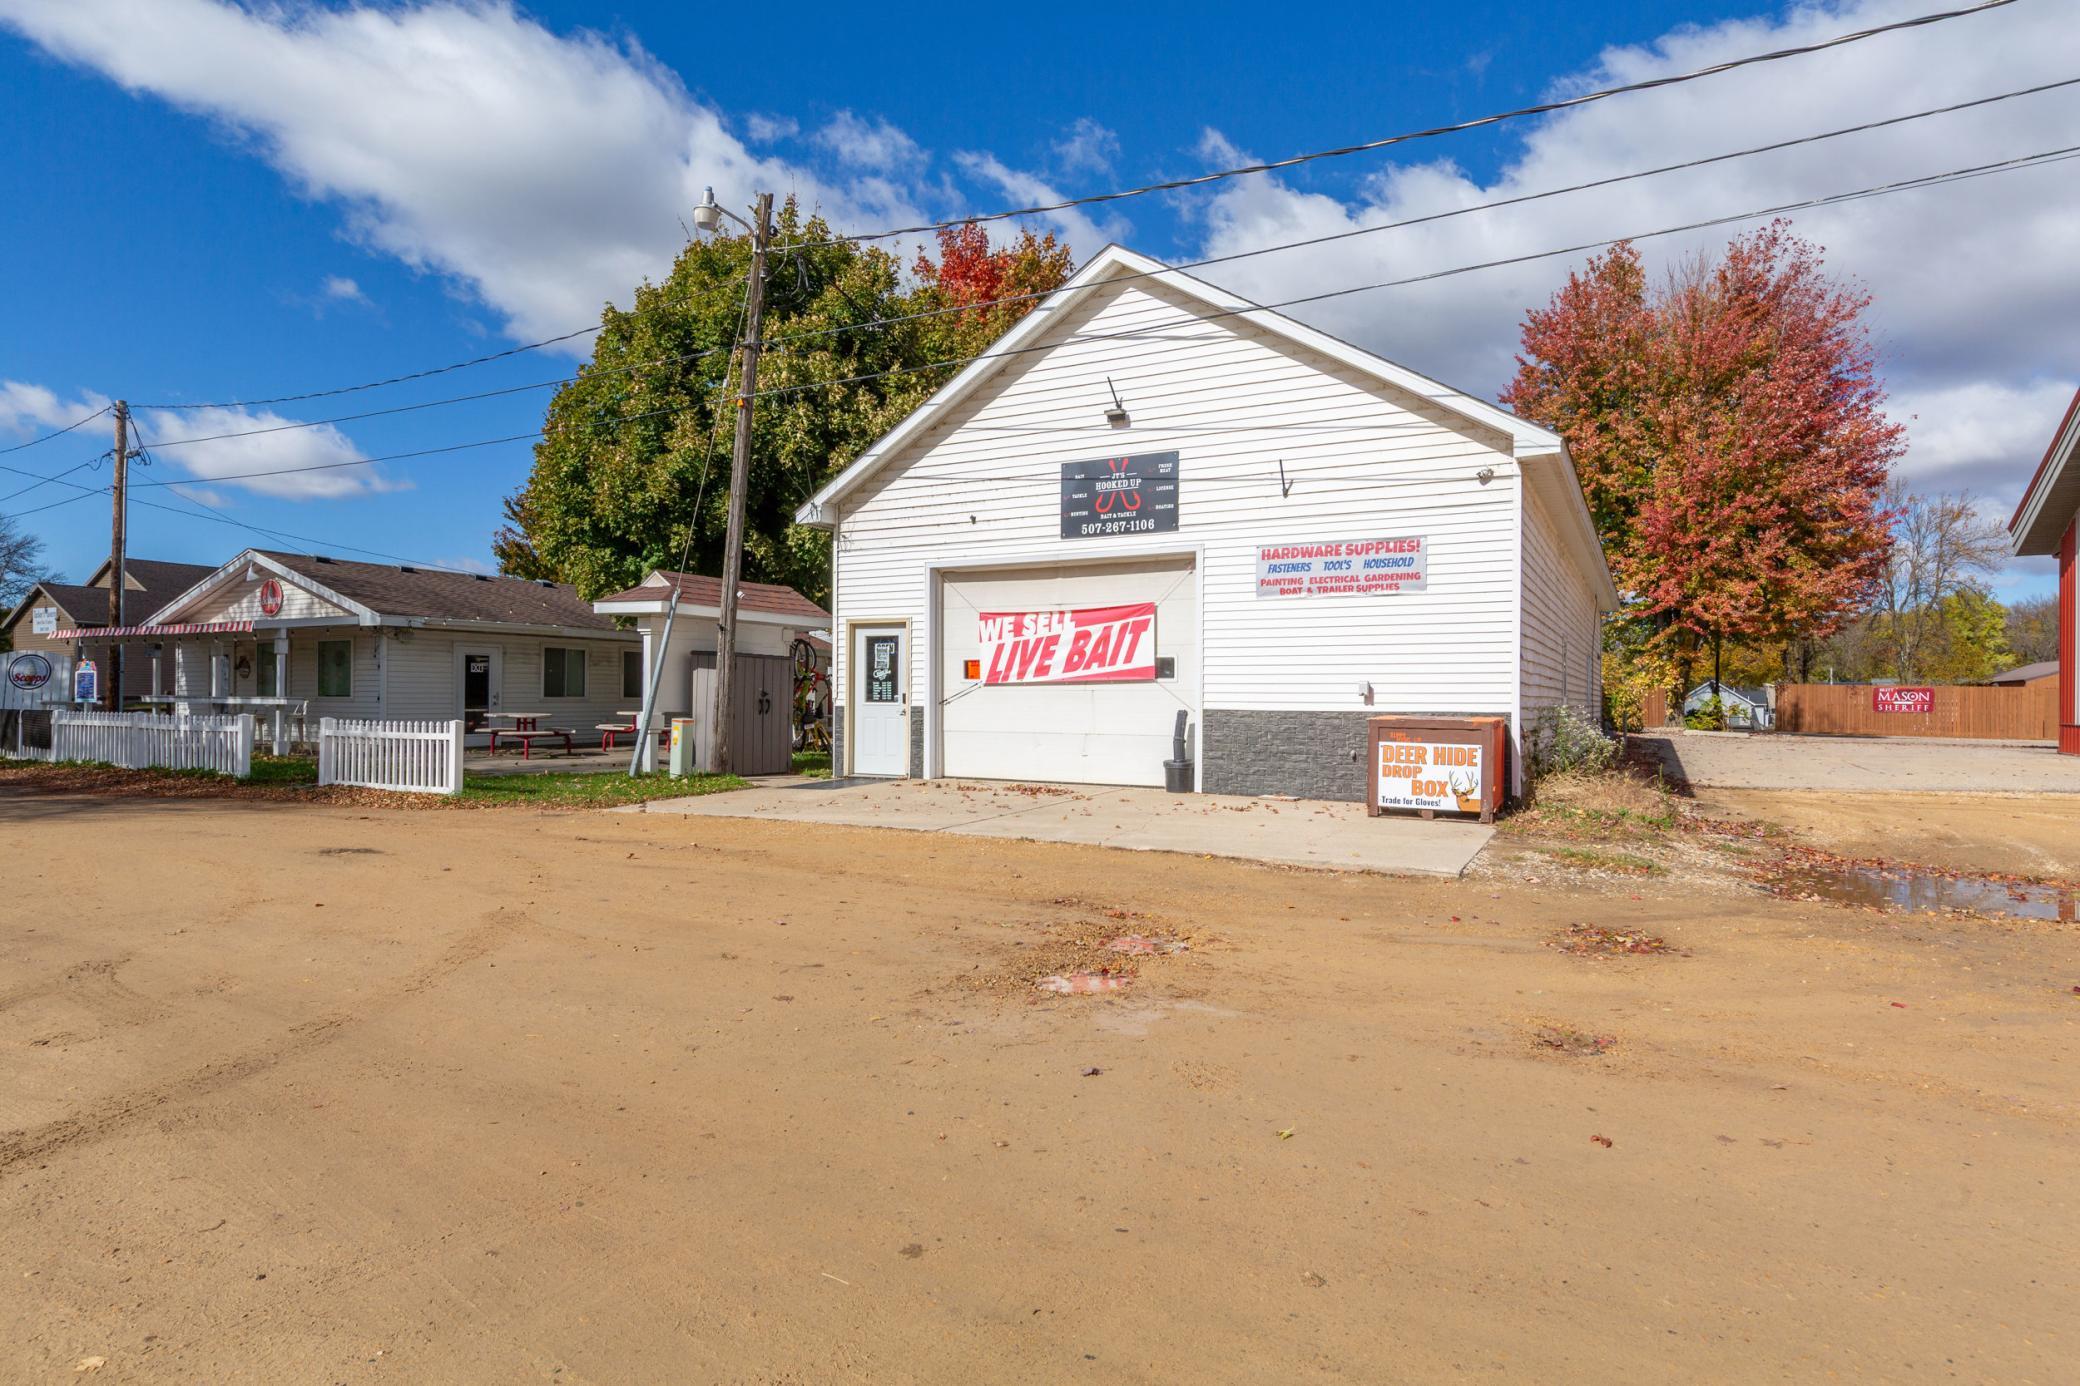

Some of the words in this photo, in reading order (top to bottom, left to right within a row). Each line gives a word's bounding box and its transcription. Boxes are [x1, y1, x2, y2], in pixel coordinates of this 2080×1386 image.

[1096, 479, 1128, 490] HOOKED
[1130, 479, 1141, 487] UP
[1081, 518, 1155, 535] 507-267-1106
[1261, 544, 1342, 560] HARDWARE
[1345, 540, 1421, 556] SUPPLIES!
[1267, 562, 1312, 574] FASTENERS
[1323, 560, 1352, 571] TOOL'S
[1363, 556, 1414, 569] HOUSEHOLD
[1260, 577, 1304, 586] PAINTING
[1309, 575, 1360, 585] ELECTRICAL
[1364, 572, 1421, 582] GARDENING
[1306, 587, 1313, 595] &
[1317, 585, 1354, 593] TRAILER
[1356, 582, 1400, 592] SUPPLIES
[979, 616, 1015, 643] WE
[1022, 611, 1076, 637] SELL
[985, 634, 1061, 683] LIVE
[1063, 618, 1151, 673] BAIT
[1878, 691, 1930, 701] MASON
[1382, 744, 1427, 765] DEER
[1433, 746, 1478, 767] HIDE
[1382, 764, 1423, 779] DROP
[1411, 779, 1449, 798] BOX
[1382, 795, 1401, 804] Trade
[1403, 797, 1413, 805] for
[1415, 797, 1441, 807] Gloves!
